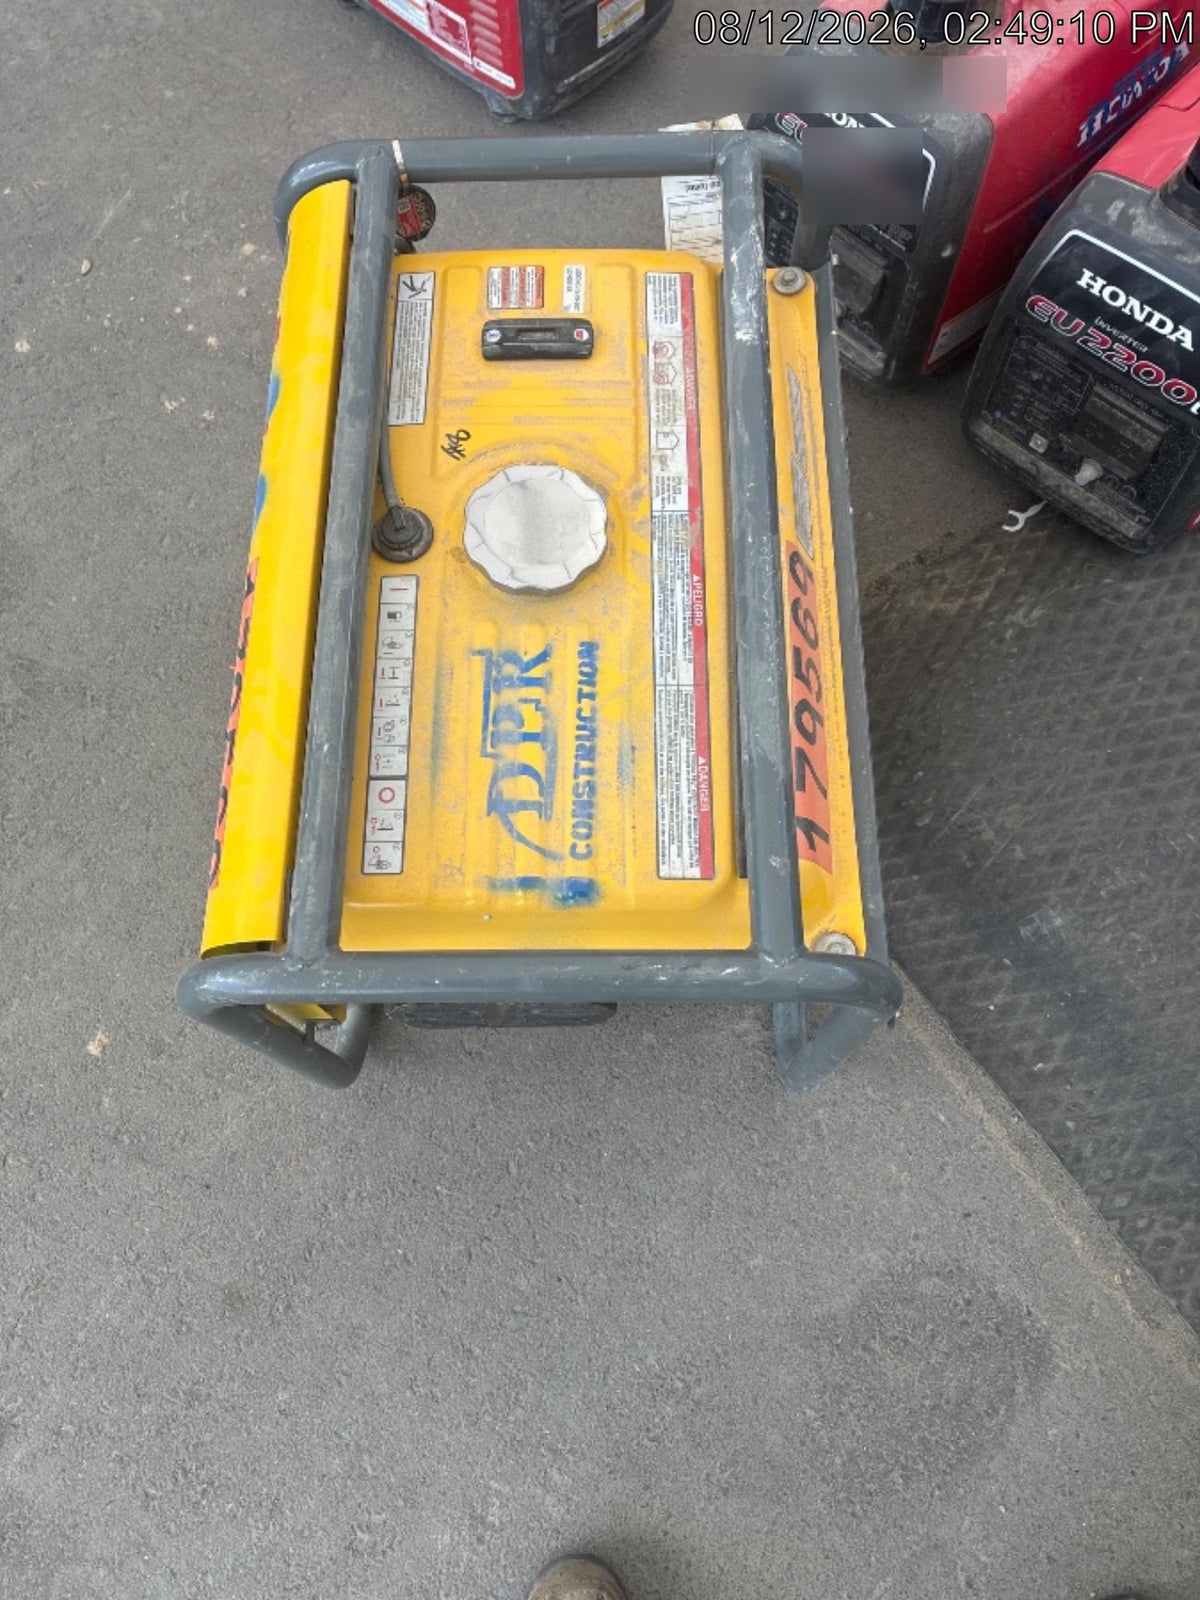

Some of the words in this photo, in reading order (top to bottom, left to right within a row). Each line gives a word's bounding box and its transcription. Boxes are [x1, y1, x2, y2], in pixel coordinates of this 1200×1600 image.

[1075, 267, 1195, 352] HONDA
[692, 582, 703, 626] PELIGRO
[481, 643, 557, 830] DPR
[568, 640, 600, 862] CONSTRUCTION
[788, 550, 829, 852] 179569
[698, 765, 709, 812] DANGER
